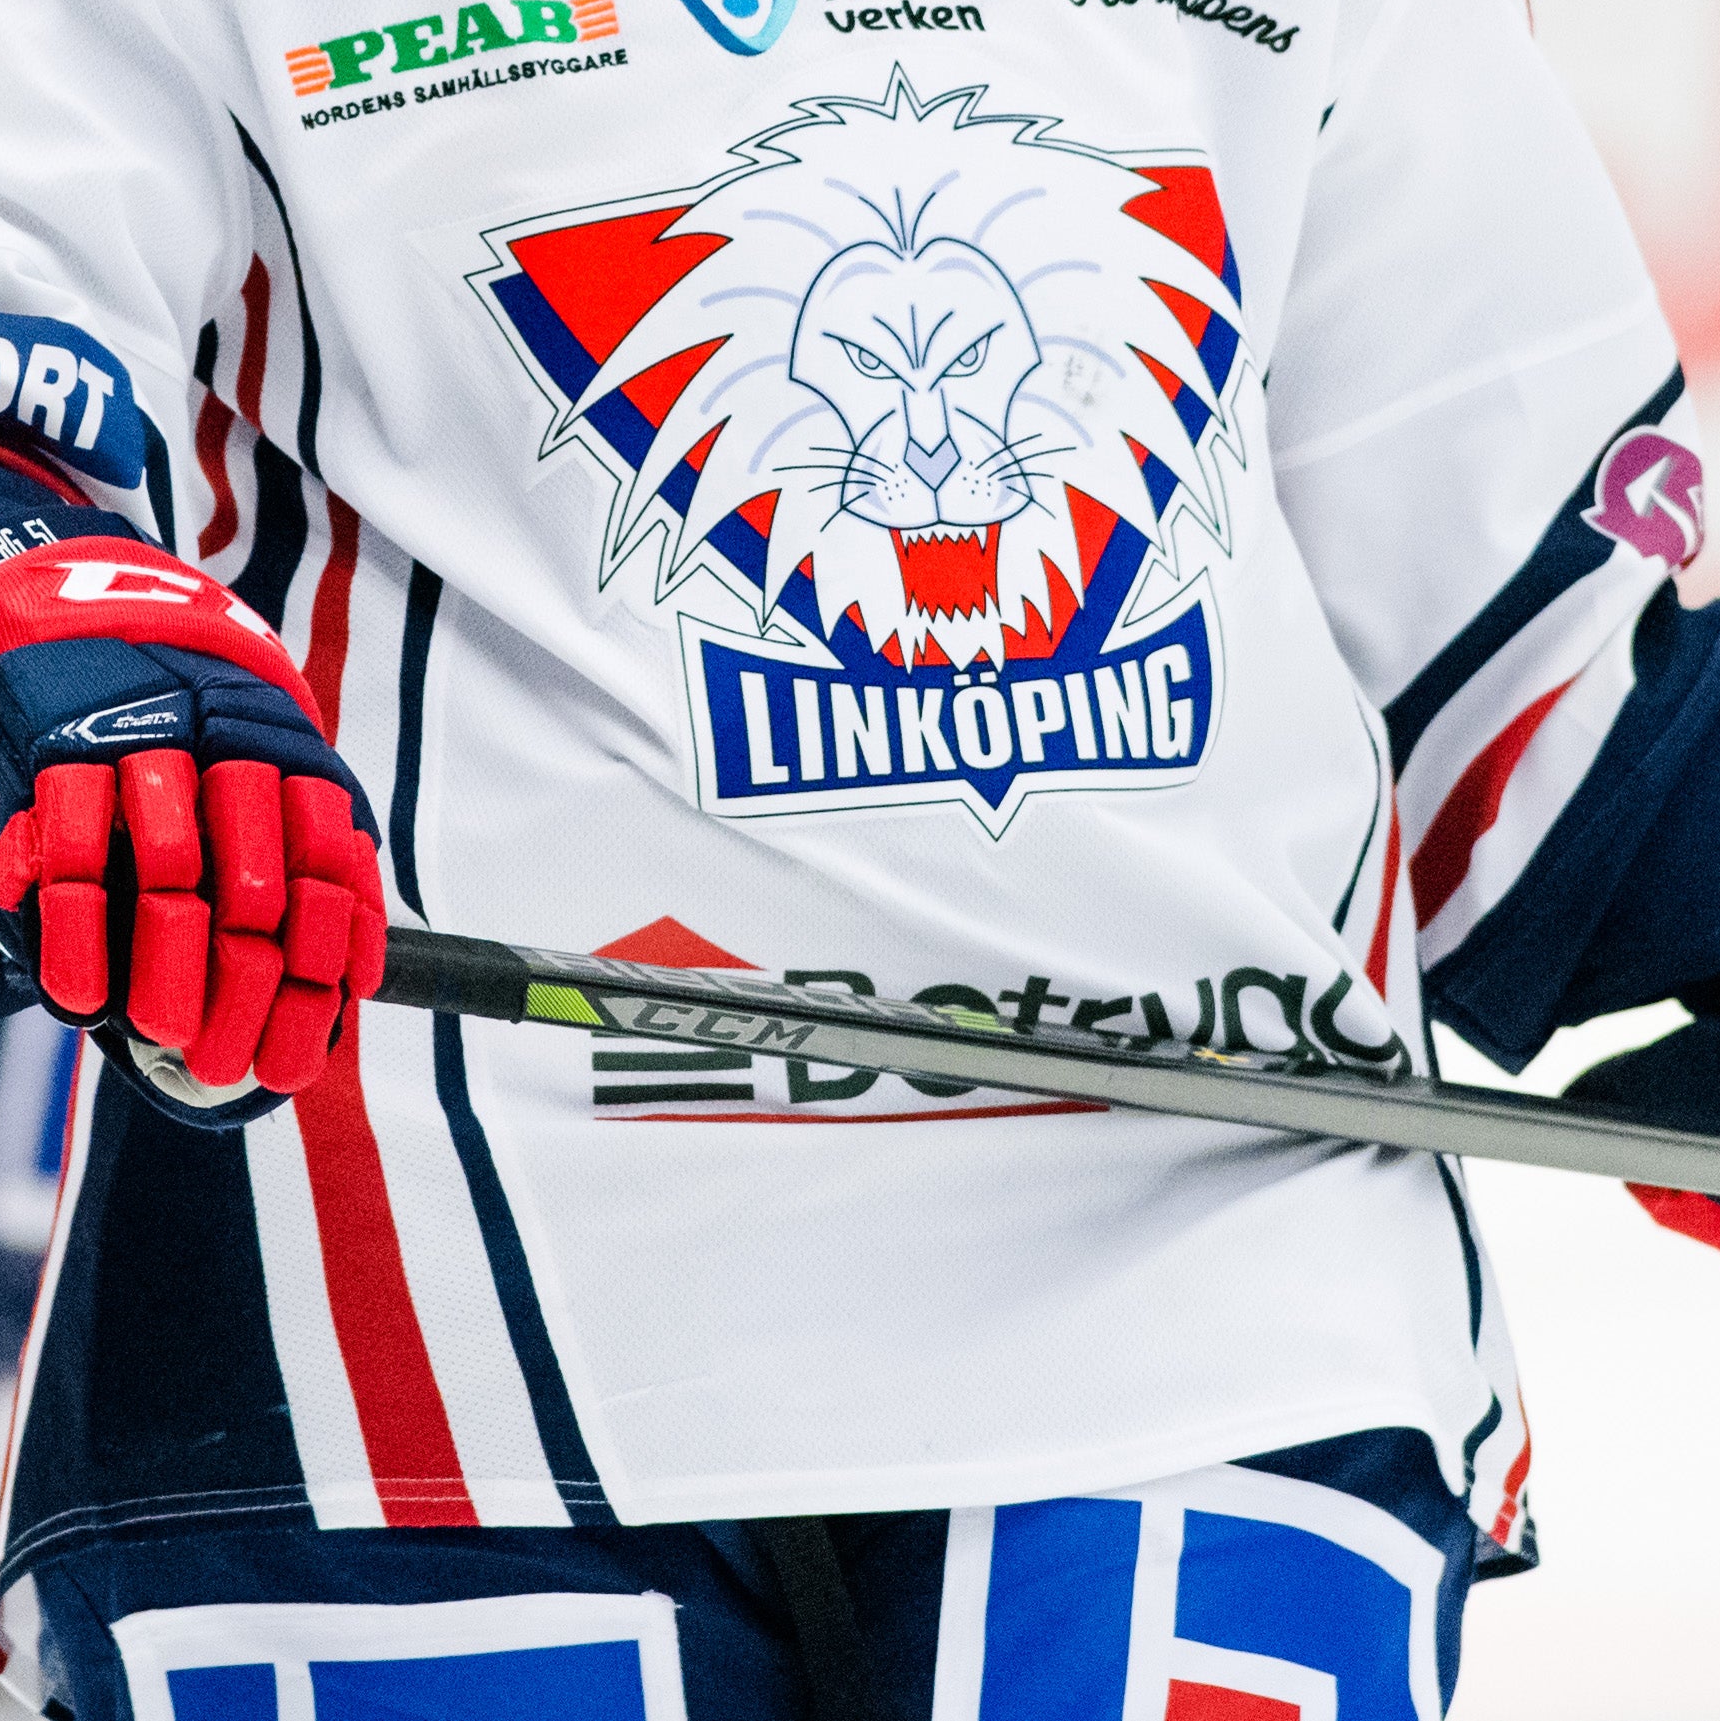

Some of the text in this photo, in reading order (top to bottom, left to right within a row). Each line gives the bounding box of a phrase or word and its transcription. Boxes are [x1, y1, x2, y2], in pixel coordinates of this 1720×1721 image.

[823, 0, 987, 34] verken
[300, 47, 629, 131] NORDENS SAMHÄLLSBYGGARE
[22, 517, 61, 547] 51
[739, 641, 1196, 788] LINKÖPING
[632, 999, 820, 1050] CCM
